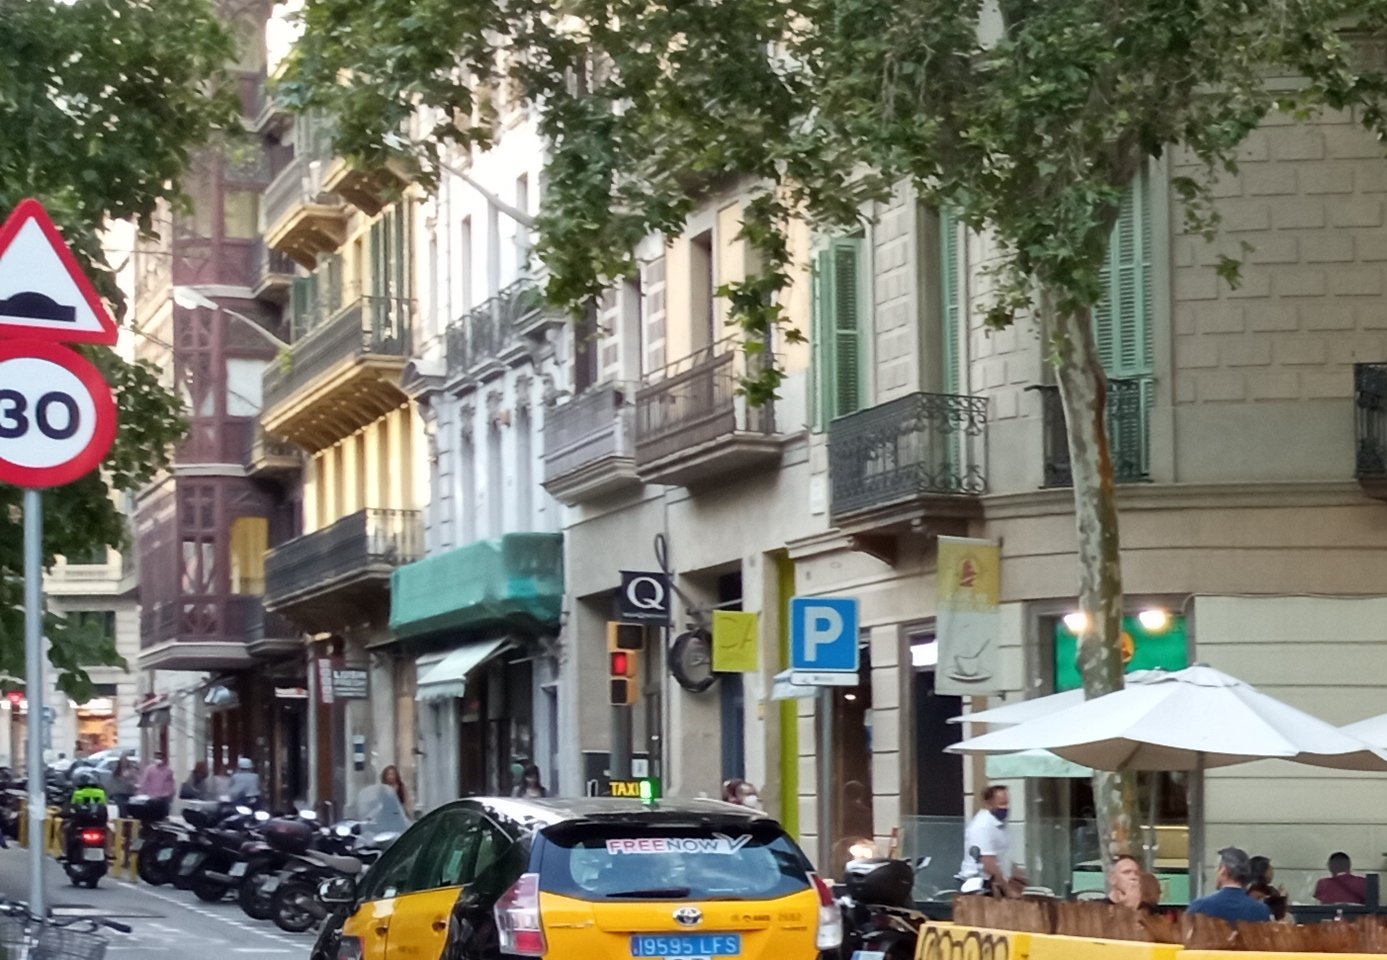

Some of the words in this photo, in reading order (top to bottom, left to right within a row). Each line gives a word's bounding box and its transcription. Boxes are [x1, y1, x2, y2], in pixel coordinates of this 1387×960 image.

[0, 389, 80, 441] 30
[627, 577, 665, 610] Q
[804, 606, 844, 662] P
[609, 782, 640, 796] TAXI
[645, 938, 694, 955] 9595
[700, 936, 737, 954] LFS
